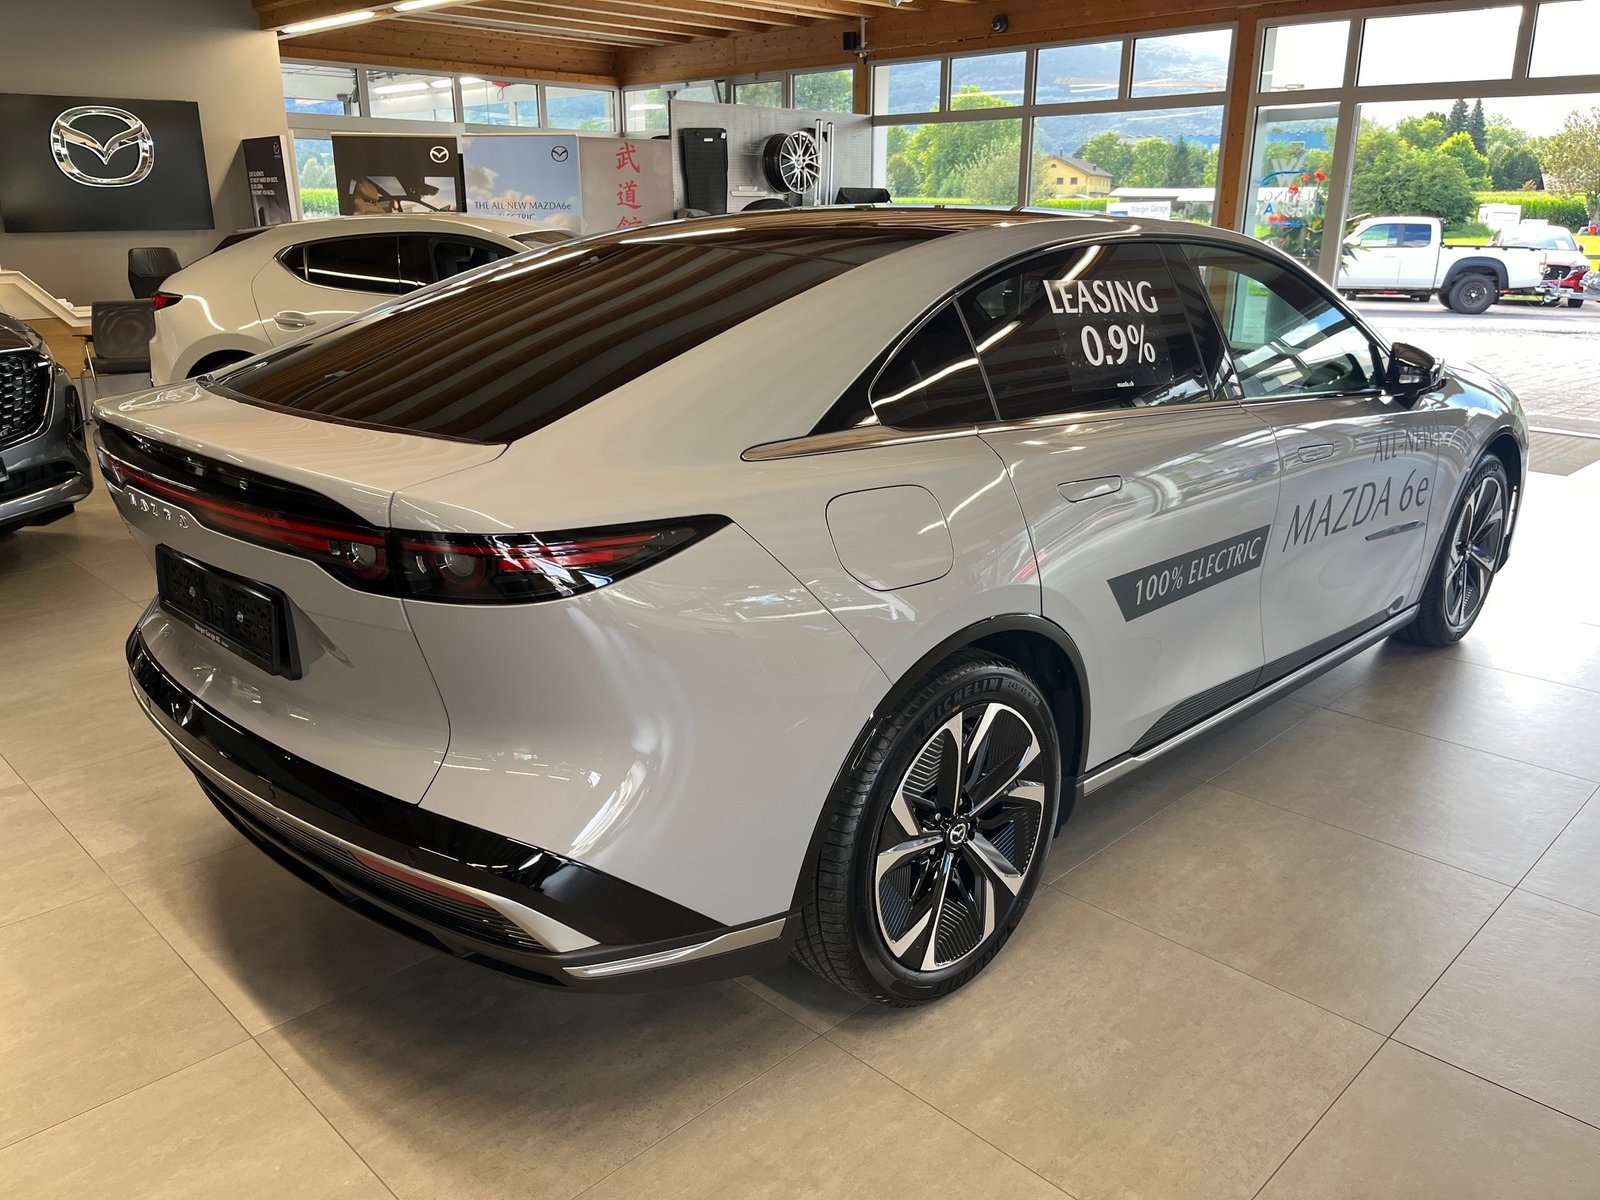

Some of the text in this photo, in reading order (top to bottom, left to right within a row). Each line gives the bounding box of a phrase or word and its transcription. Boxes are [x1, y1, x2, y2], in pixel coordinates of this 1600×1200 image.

[474, 201, 572, 210] THE ALL-NEW MAZDA6e
[1042, 279, 1159, 314] LEASING
[1080, 324, 1156, 367] 0.9%
[1282, 468, 1430, 553] MAZDA 6e
[1135, 536, 1262, 606] 100% ELECTRIC
[922, 678, 1001, 728] MICHELIN
